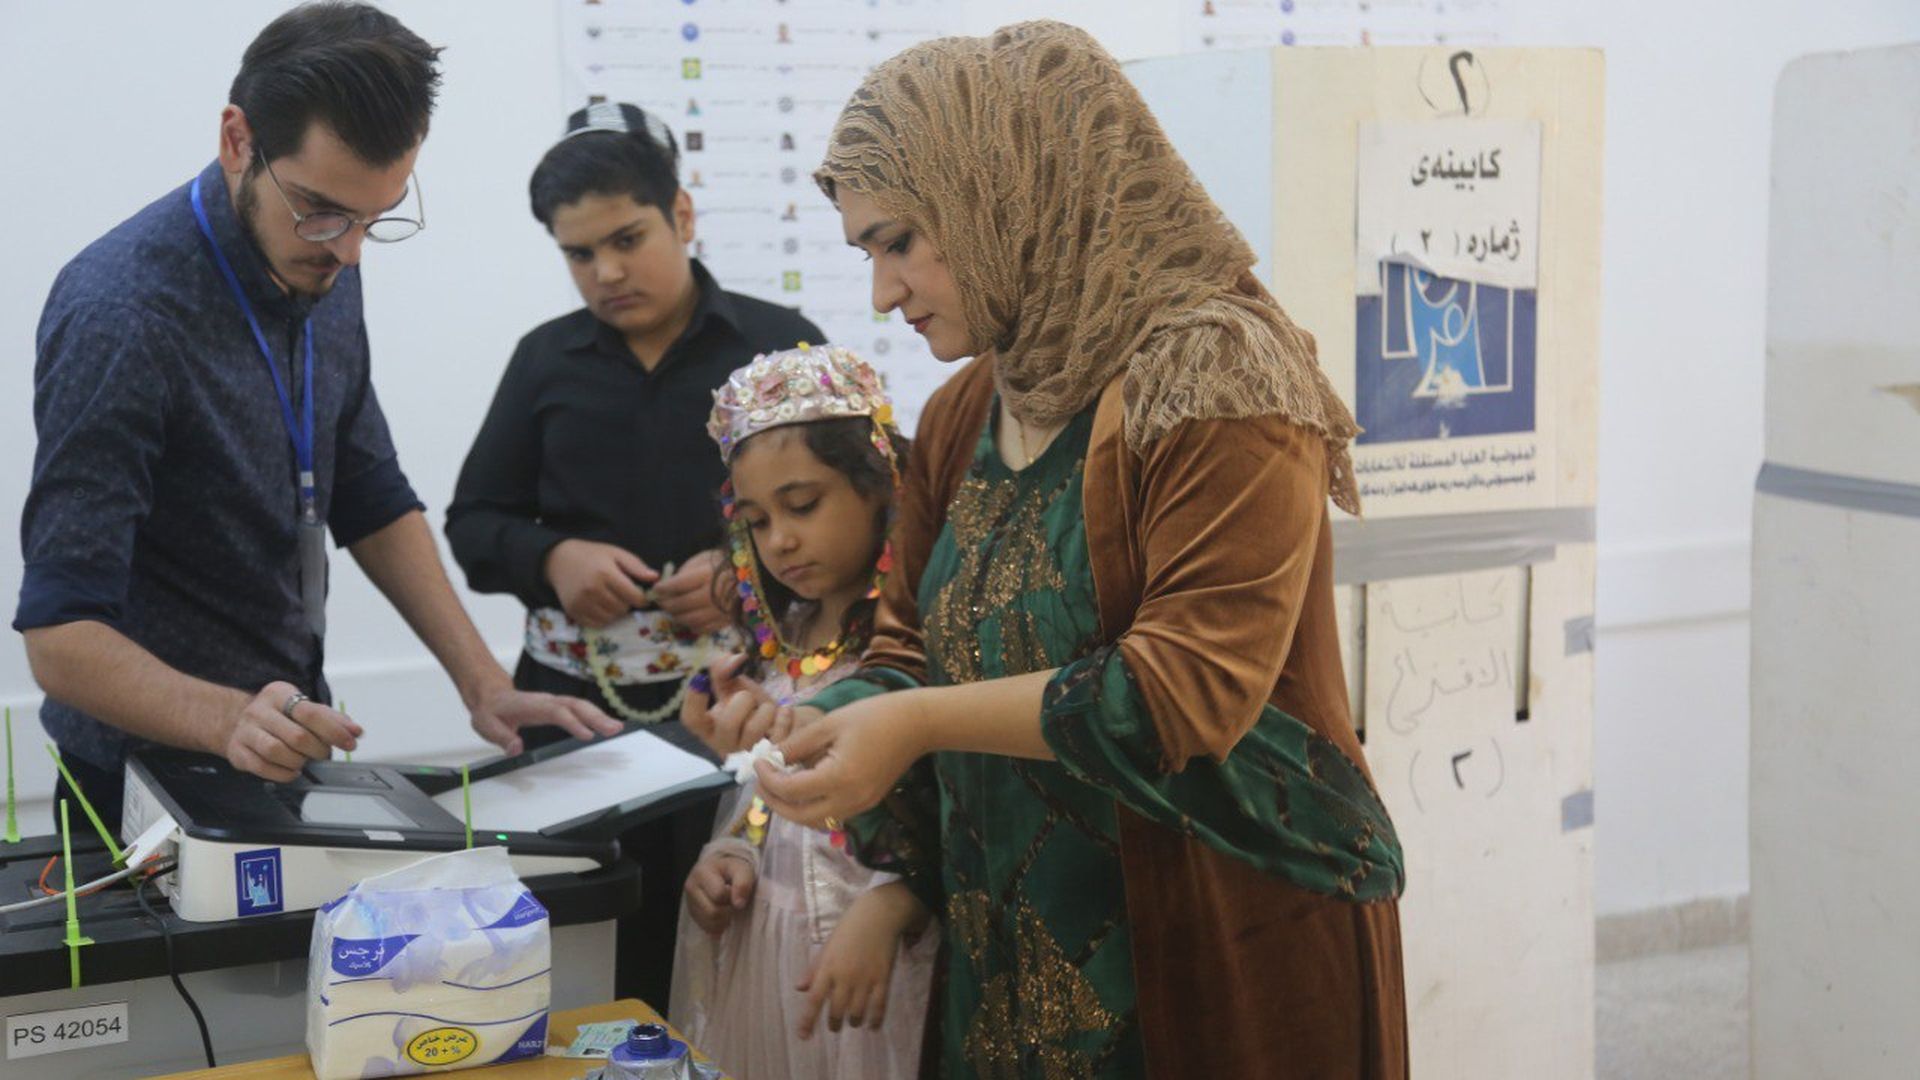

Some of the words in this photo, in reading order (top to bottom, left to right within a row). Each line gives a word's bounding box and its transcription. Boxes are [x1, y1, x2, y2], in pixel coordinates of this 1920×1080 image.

[14, 1025, 46, 1046] PS
[54, 1016, 122, 1041] 42054
[425, 1047, 438, 1058] 20
